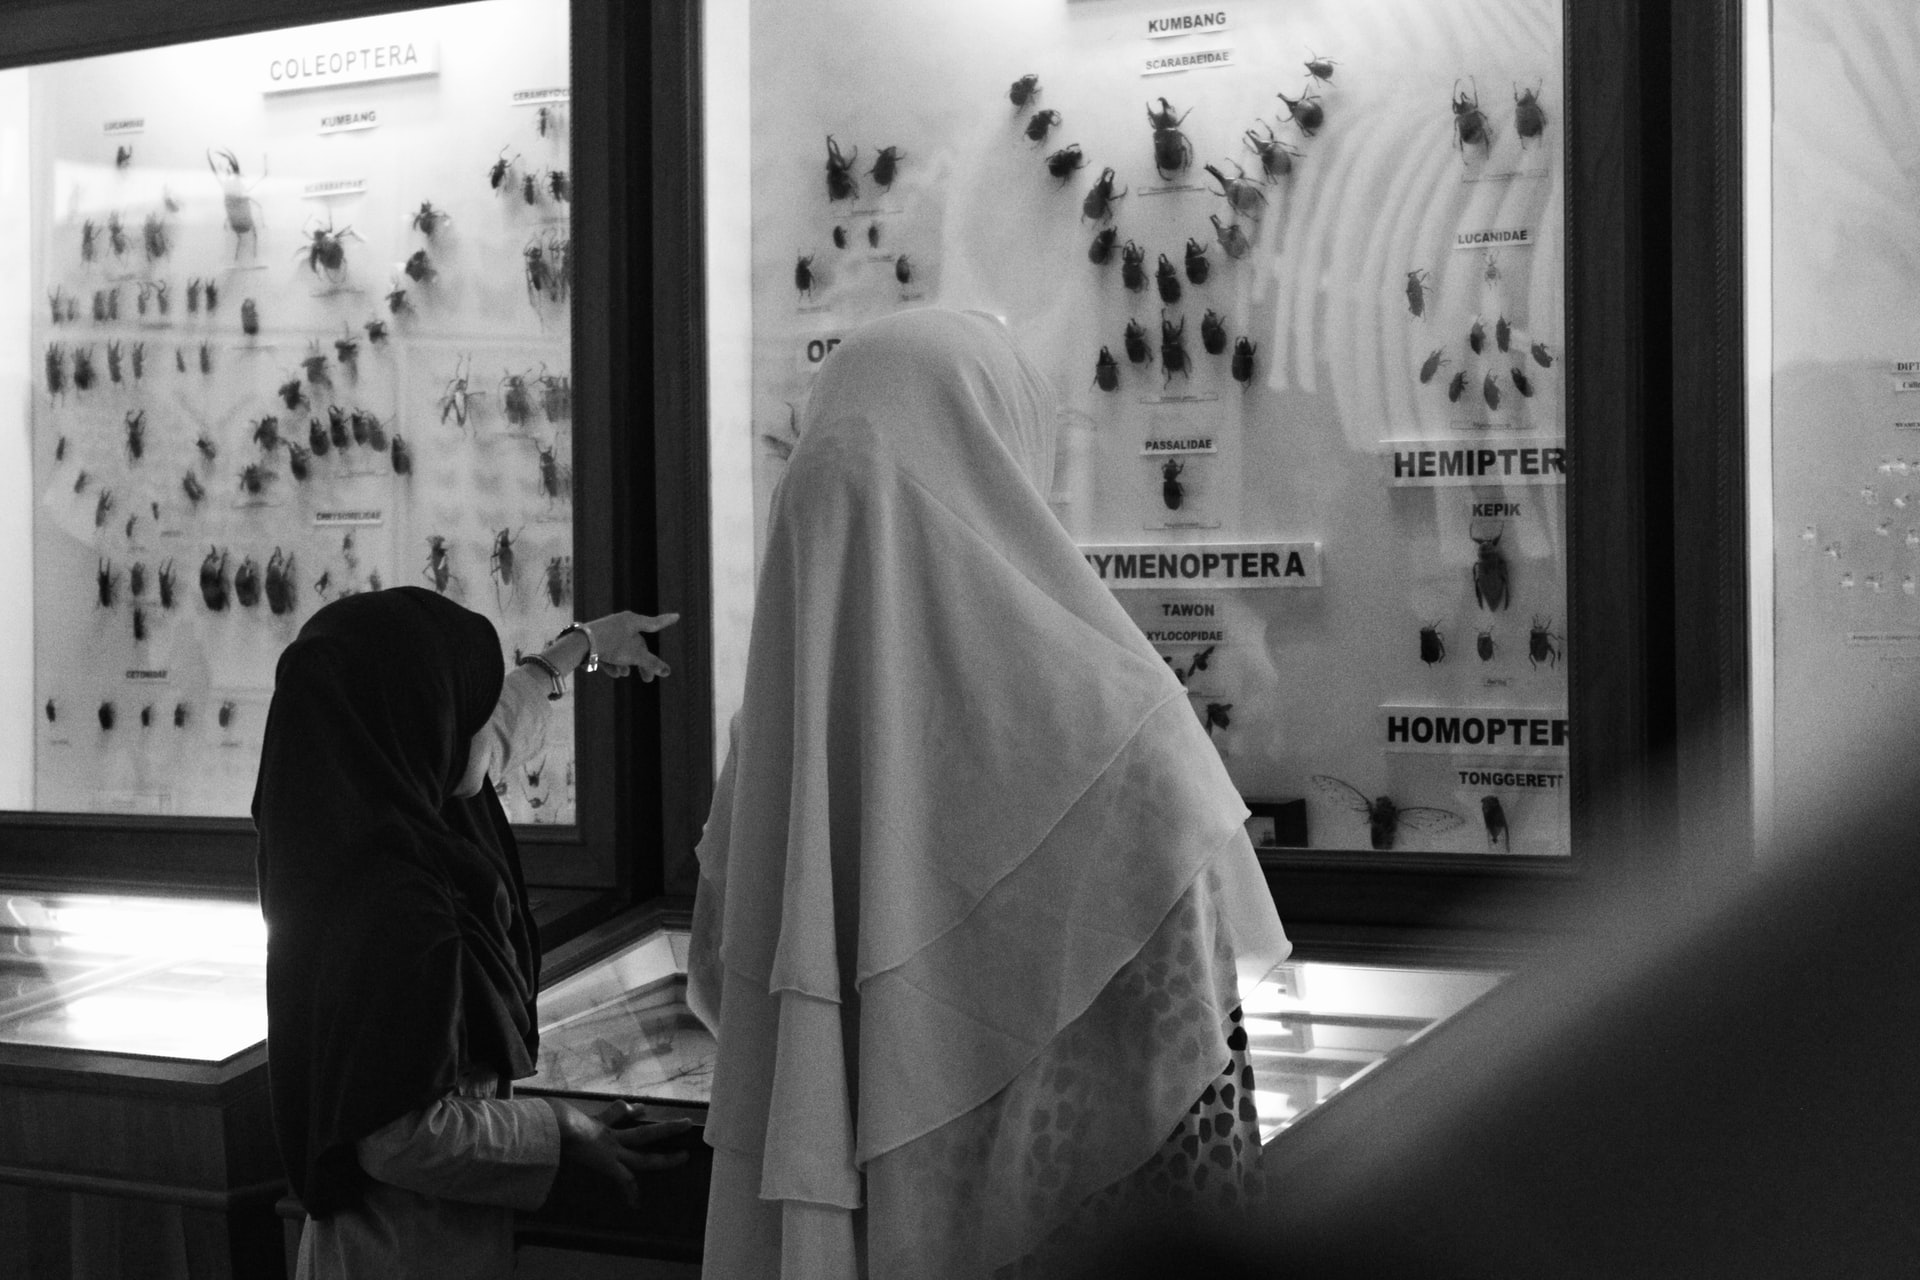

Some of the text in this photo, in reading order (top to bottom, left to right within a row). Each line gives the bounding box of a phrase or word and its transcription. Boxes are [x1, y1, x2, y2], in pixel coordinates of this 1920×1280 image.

[1148, 12, 1226, 33] KUMBANG
[270, 43, 418, 81] COLEOPTERA
[1145, 51, 1230, 70] SCARABAEIDAE
[321, 110, 377, 128] KUMBANG
[1458, 229, 1528, 244] LUCANIDAE
[1145, 439, 1213, 450] PASSALIDAE
[1394, 448, 1567, 478] HEMIPTER
[1472, 503, 1522, 517] KEPIK
[1162, 603, 1215, 617] TAWON
[1146, 631, 1223, 642] XYLOCOPIDAE
